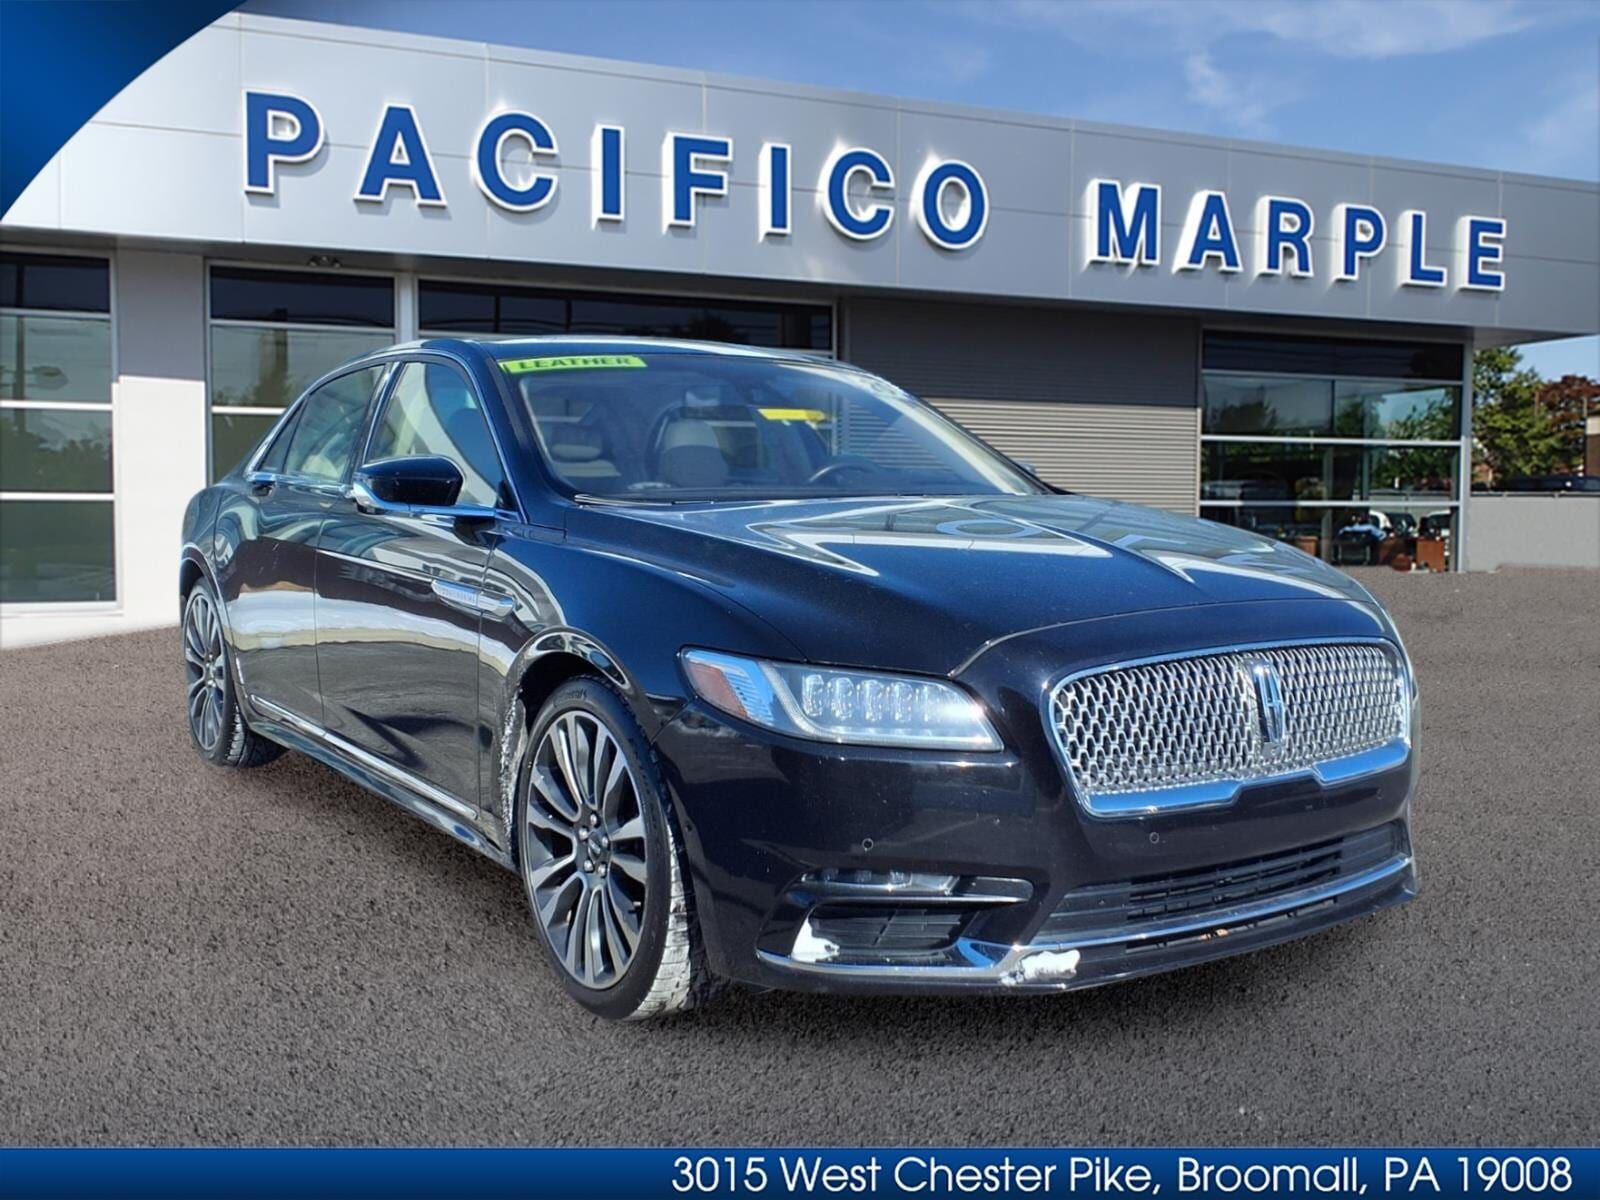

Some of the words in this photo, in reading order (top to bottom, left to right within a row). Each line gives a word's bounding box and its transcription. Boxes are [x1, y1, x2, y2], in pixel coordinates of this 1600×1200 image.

[244, 90, 989, 250] PACIFICO
[1089, 180, 1506, 292] MARPLE
[519, 357, 630, 370] LEATHER
